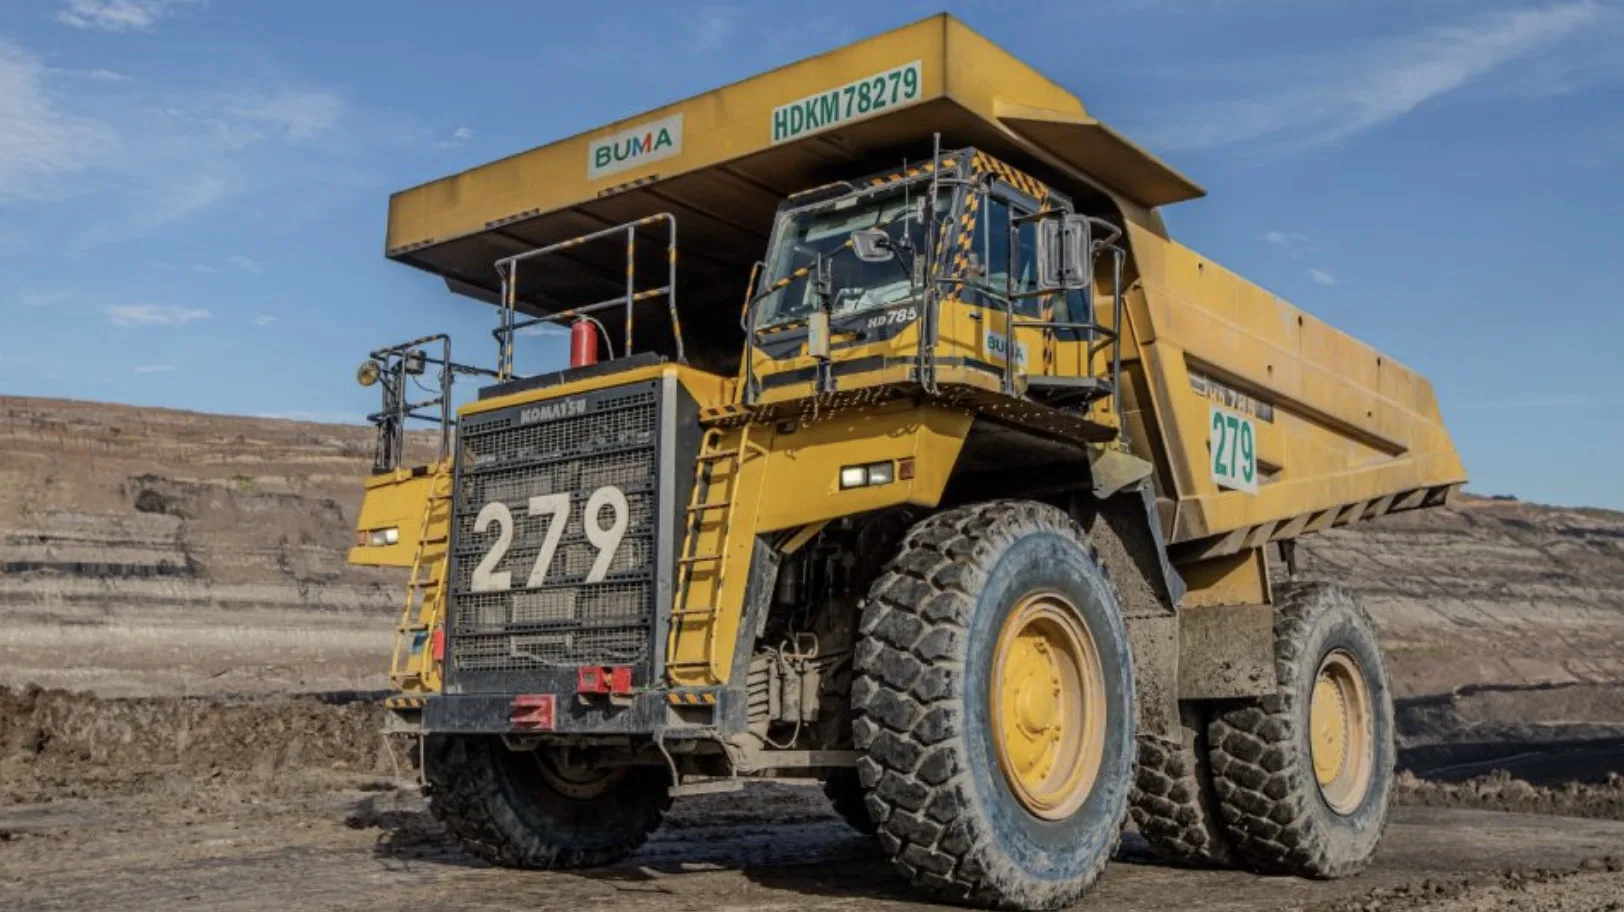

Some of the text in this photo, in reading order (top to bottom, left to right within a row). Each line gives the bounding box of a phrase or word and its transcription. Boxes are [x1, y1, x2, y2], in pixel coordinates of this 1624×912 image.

[774, 67, 917, 140] HDKM78279
[595, 128, 672, 168] BUMA
[988, 336, 1024, 361] BUA
[520, 399, 586, 423] KOMATSU
[1213, 412, 1253, 483] 279
[471, 485, 629, 592] 279
